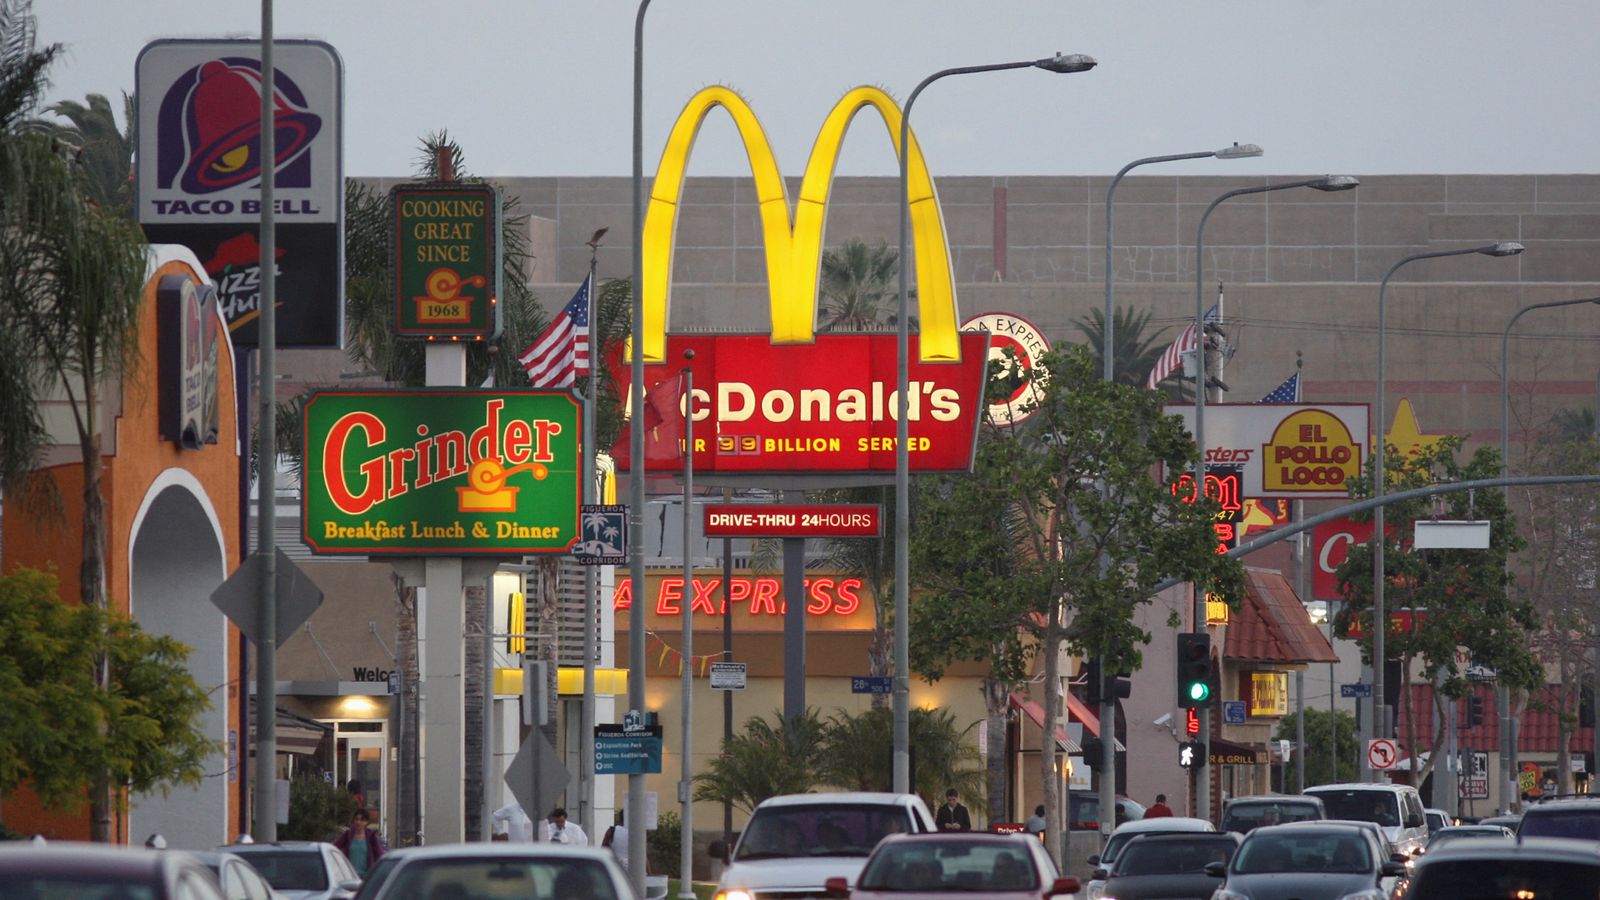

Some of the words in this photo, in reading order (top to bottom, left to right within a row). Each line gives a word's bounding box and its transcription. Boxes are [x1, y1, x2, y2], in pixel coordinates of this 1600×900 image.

[152, 200, 234, 215] TACO
[402, 200, 484, 217] COOKING
[414, 222, 473, 240] GREAT
[417, 245, 471, 262] SINCE
[427, 304, 460, 317] 1968
[1299, 424, 1327, 442] EL
[765, 437, 841, 452] BILLION
[322, 399, 562, 515] Grinder
[1205, 447, 1255, 462] sters
[1275, 446, 1351, 463] POLLO
[1281, 467, 1345, 485] LOCO
[709, 514, 796, 527] DRIVE-THRU
[324, 521, 405, 541] Breakfast
[410, 521, 465, 538] Lunch
[471, 522, 490, 538] &
[496, 521, 560, 538] Dinner
[656, 577, 863, 615] EXPRSS
[1226, 755, 1254, 763] GRILL
